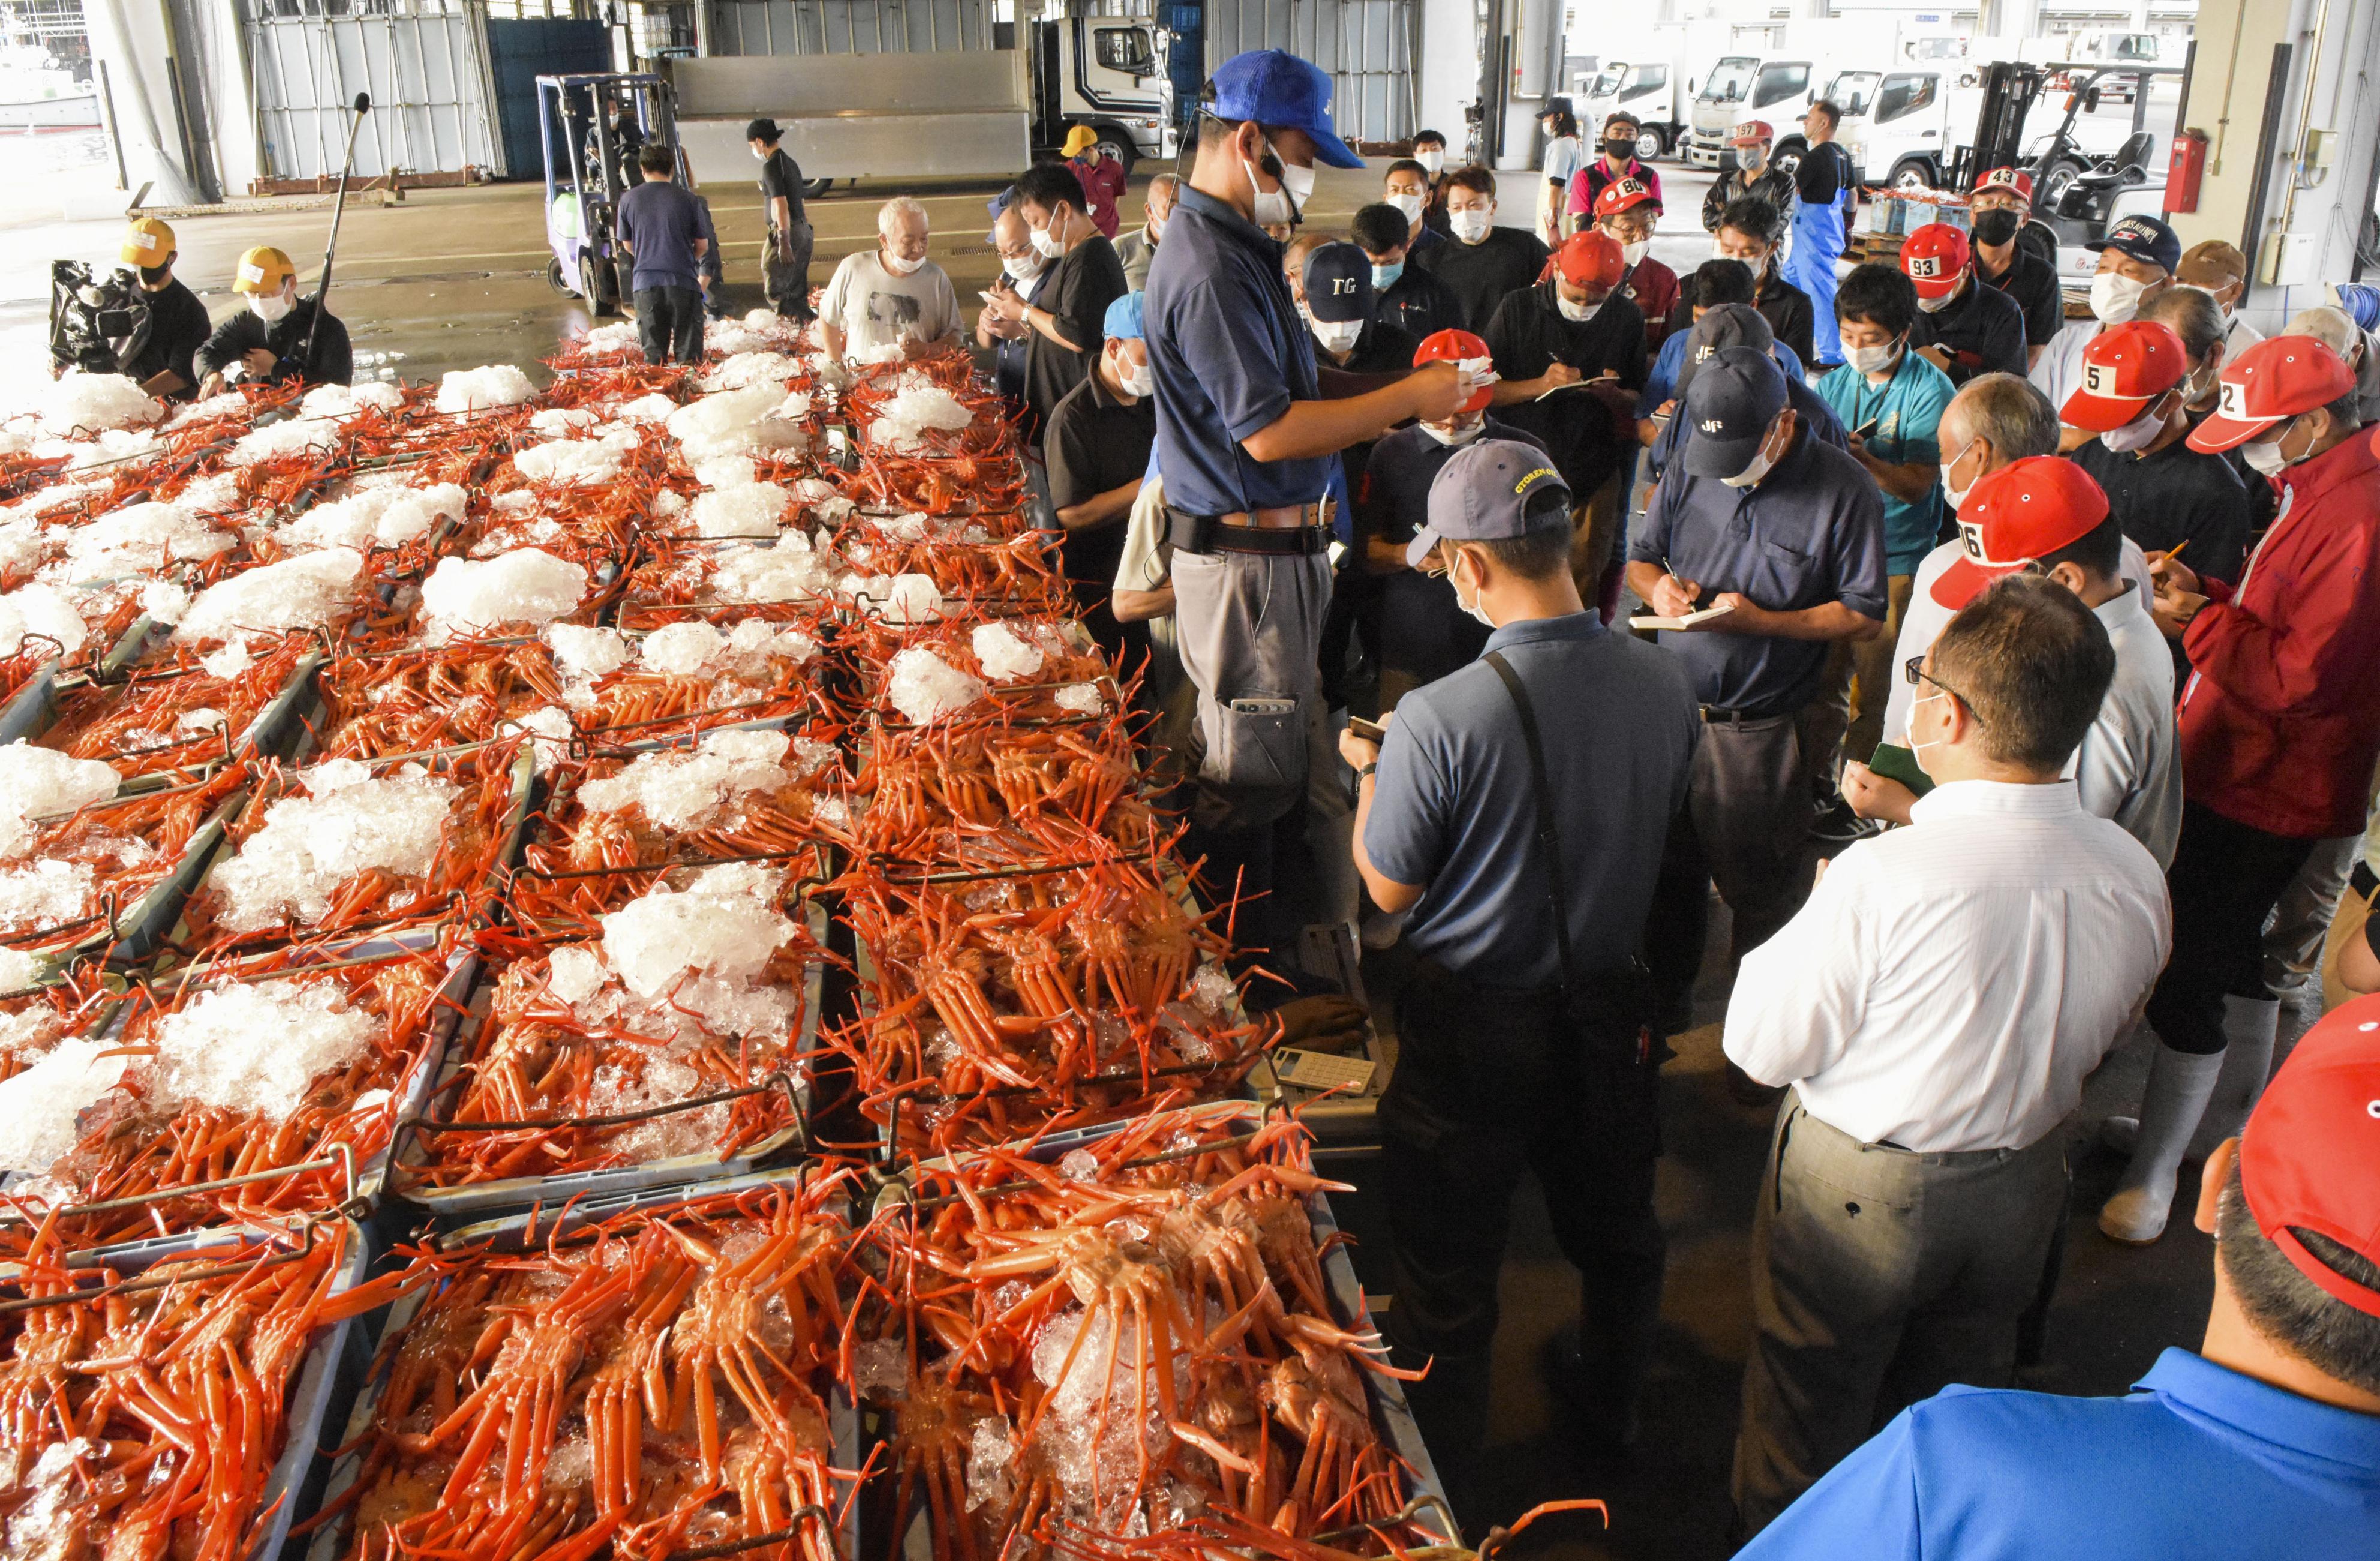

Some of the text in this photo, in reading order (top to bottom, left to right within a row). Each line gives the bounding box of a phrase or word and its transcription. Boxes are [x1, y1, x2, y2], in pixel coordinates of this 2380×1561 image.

[1741, 125, 1753, 135] 97
[1993, 170, 2013, 184] 43
[1913, 260, 1933, 275] 93
[1333, 278, 1356, 295] TG
[1695, 345, 1715, 360] JF
[2088, 366, 2100, 391] 5
[1702, 419, 1723, 433] JF
[1546, 468, 1558, 478] OIL
